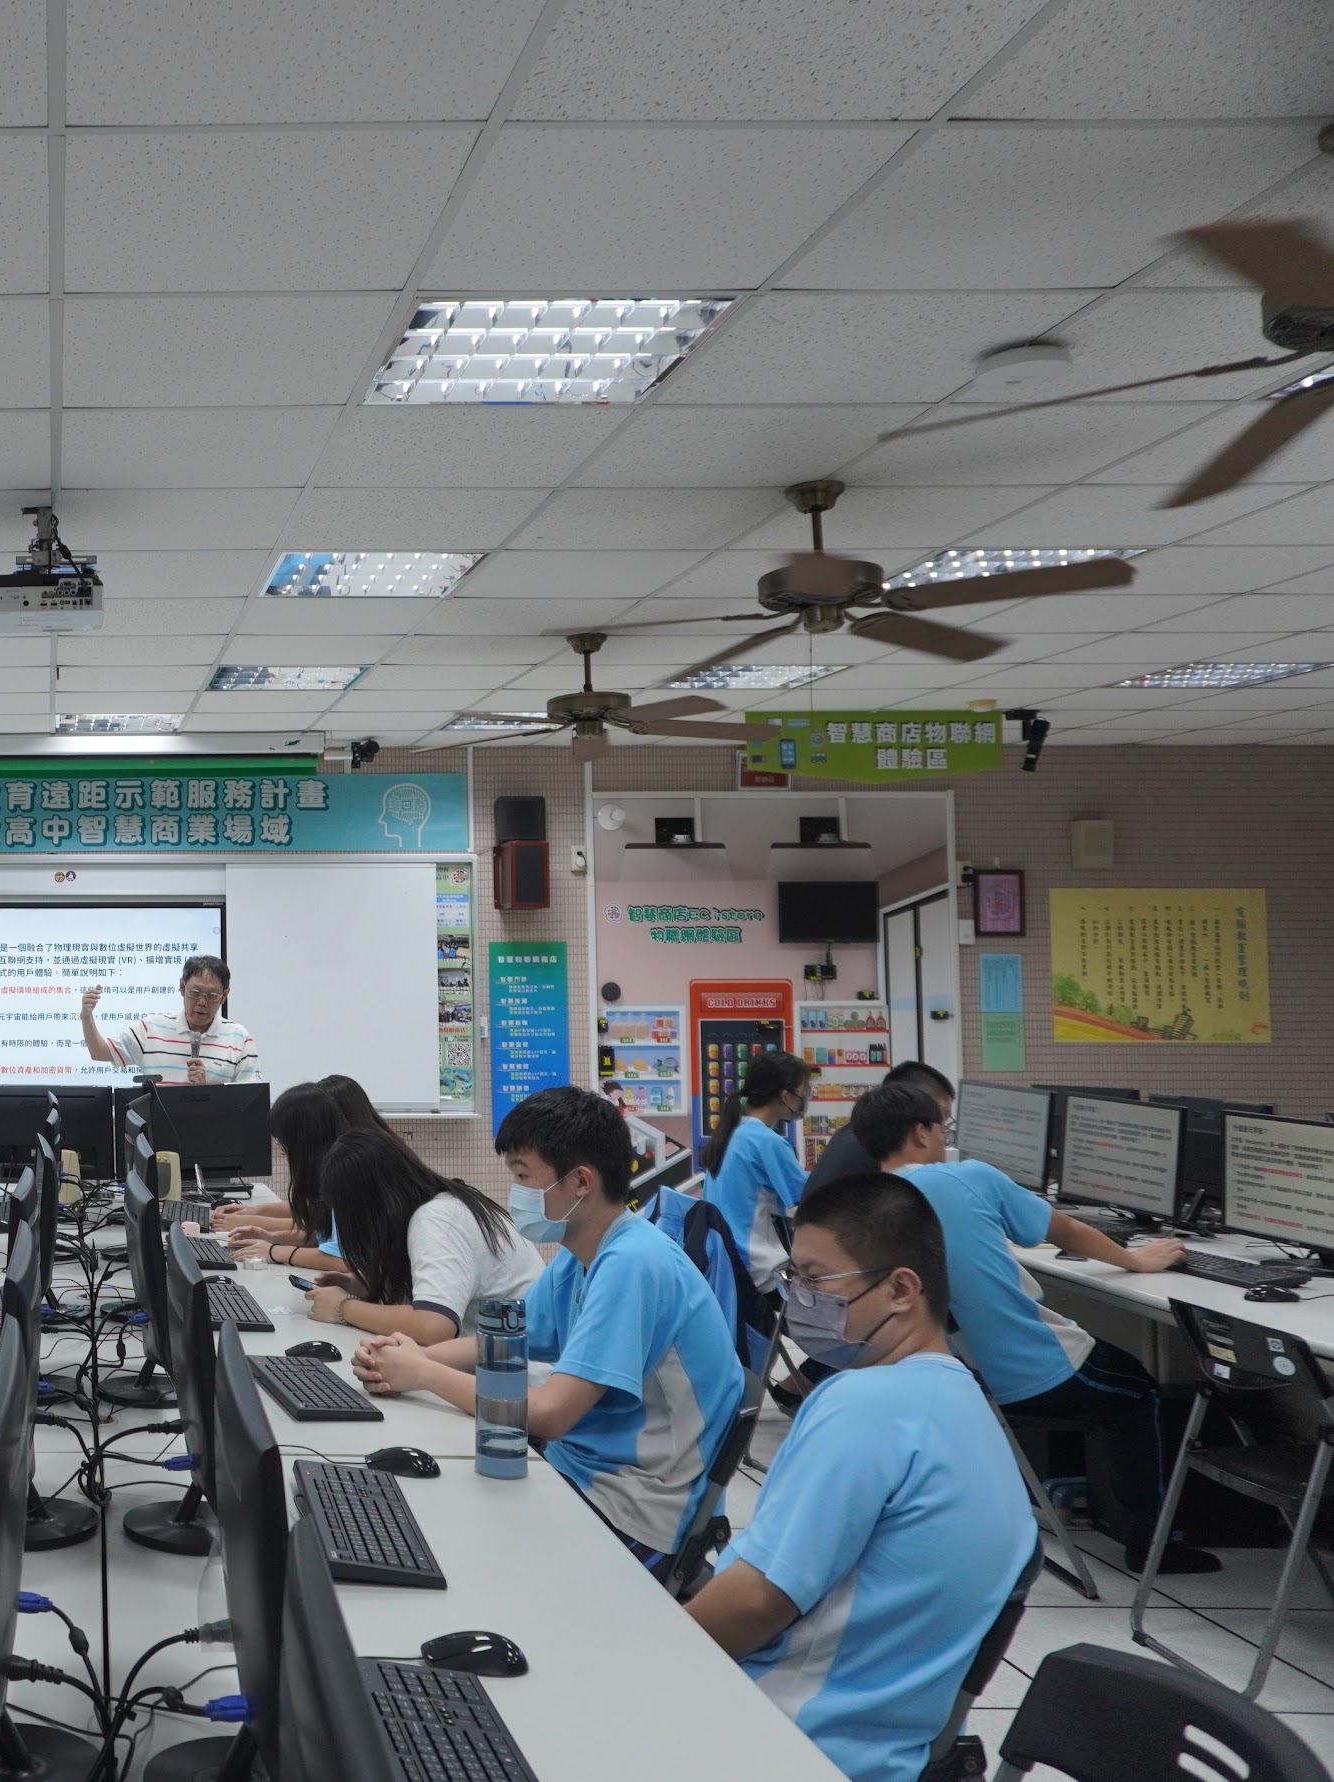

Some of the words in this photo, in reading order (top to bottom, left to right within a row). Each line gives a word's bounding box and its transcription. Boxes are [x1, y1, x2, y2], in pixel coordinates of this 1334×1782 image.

[827, 721, 996, 744] 智慧商店物聯網
[876, 748, 947, 769] 體驗區
[627, 905, 710, 921] 智慧商店EC
[650, 926, 742, 944] 物聯網體驗區
[707, 997, 734, 1008] COLD
[736, 997, 777, 1008] DRINKS
